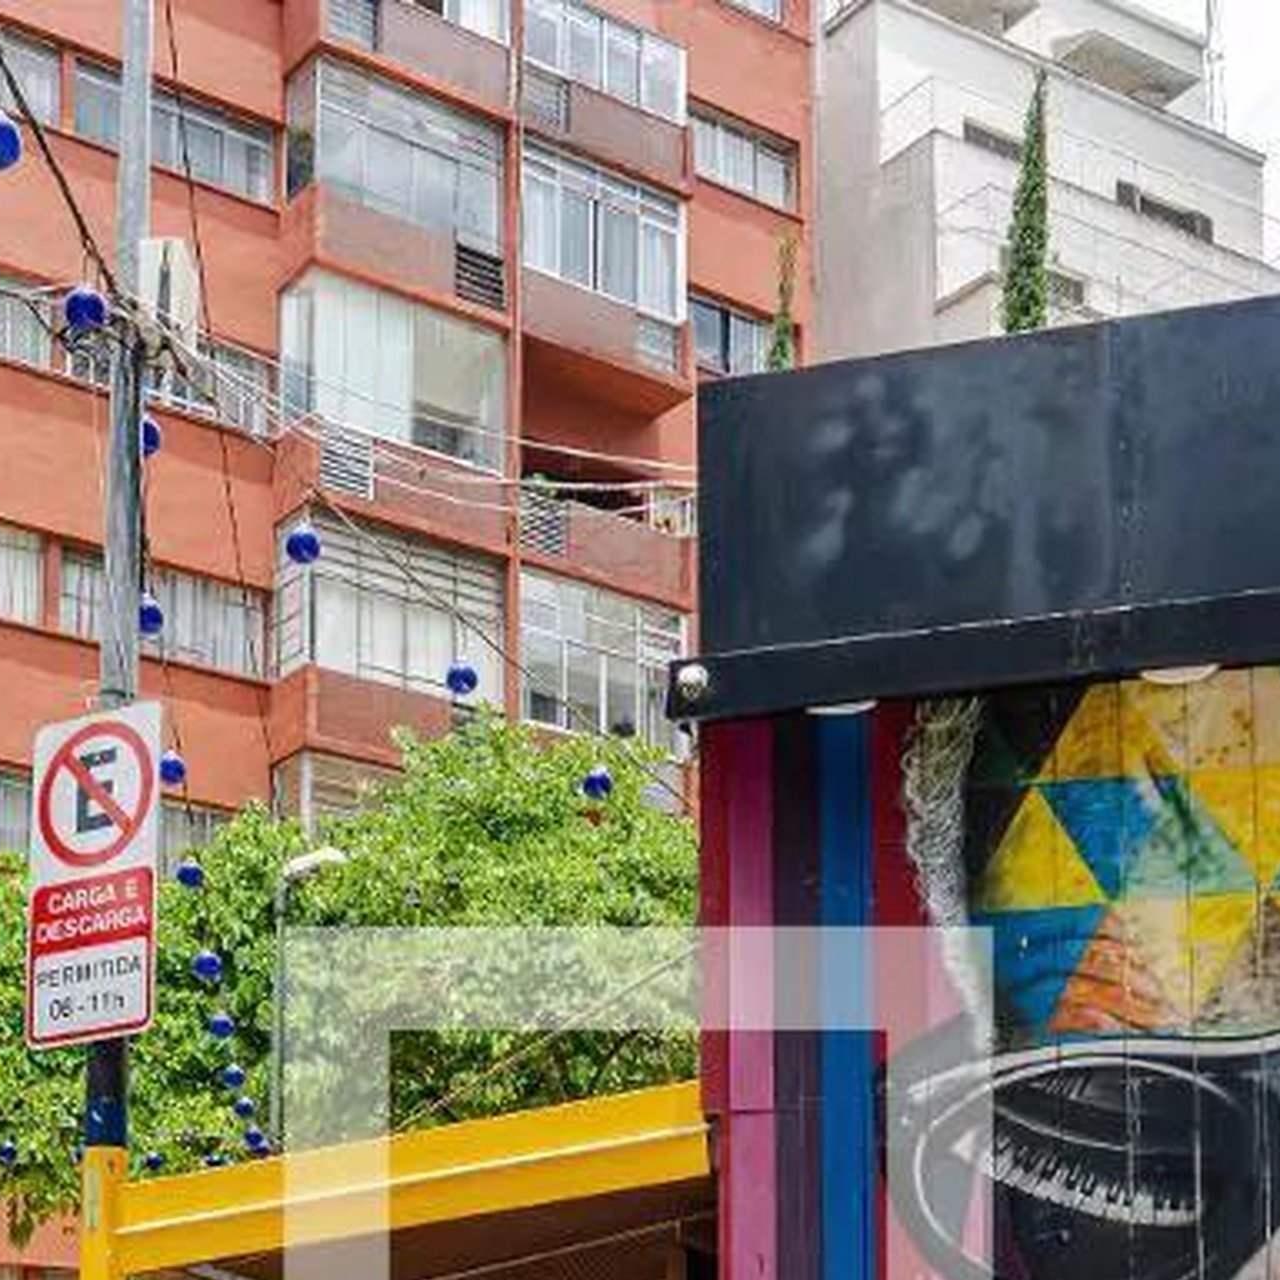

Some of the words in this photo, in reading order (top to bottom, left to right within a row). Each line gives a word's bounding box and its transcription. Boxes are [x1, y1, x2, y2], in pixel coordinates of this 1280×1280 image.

[76, 746, 118, 833] E
[47, 883, 117, 914] CARGA
[124, 877, 139, 899] E
[35, 905, 149, 946] DESCARGA
[36, 955, 142, 988] PERMITIDA
